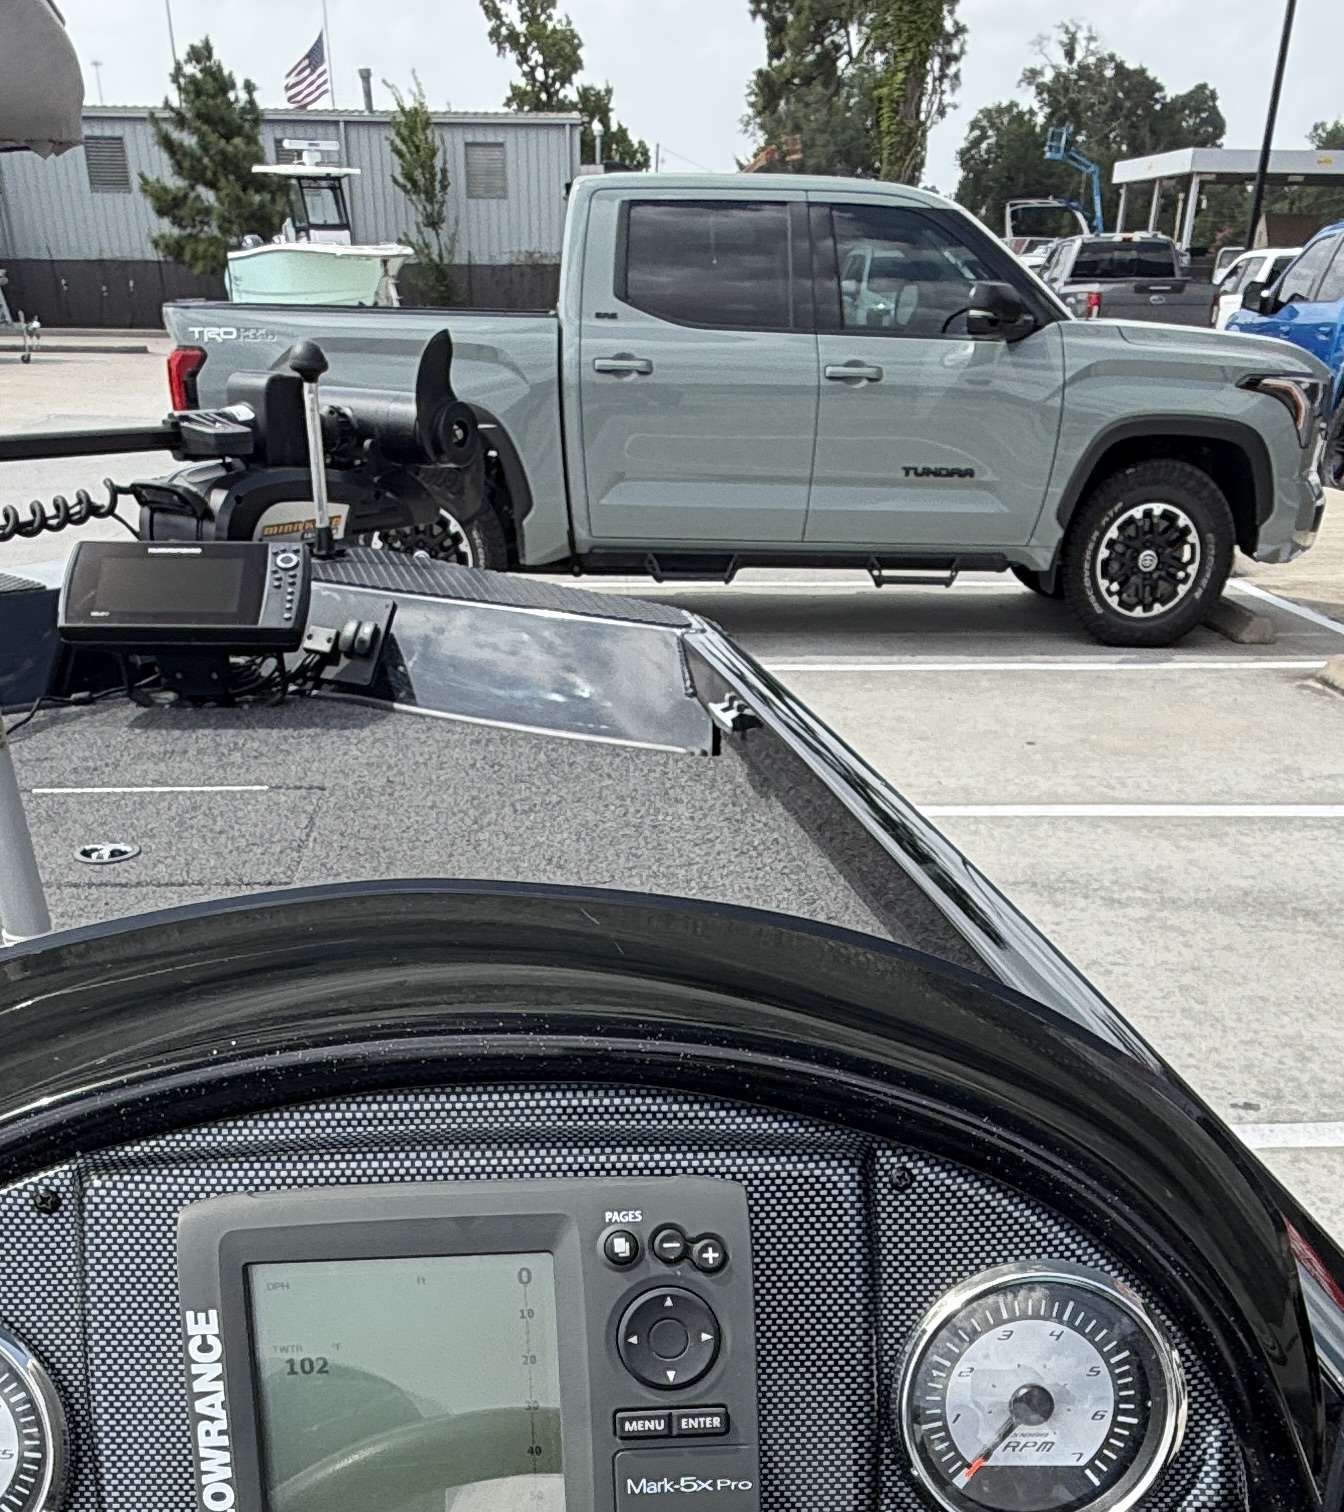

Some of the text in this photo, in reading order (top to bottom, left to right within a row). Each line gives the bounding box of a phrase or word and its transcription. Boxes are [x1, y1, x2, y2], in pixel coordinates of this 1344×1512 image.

[901, 466, 975, 478] TUNDRA
[605, 1210, 643, 1223] PAGES
[517, 1267, 533, 1285] 0
[519, 1308, 535, 1320] 10
[997, 1329, 1015, 1341] 3
[1049, 1329, 1065, 1342] 4
[285, 1356, 330, 1377] 102
[957, 1366, 975, 1378] 2
[1085, 1365, 1102, 1377] 5
[951, 1412, 961, 1424] 1
[1090, 1409, 1108, 1421] 6
[624, 1416, 722, 1432] MENU ENTER
[1001, 1440, 1057, 1453] RPM
[1071, 1451, 1084, 1463] 7
[716, 1478, 753, 1492] Pro
